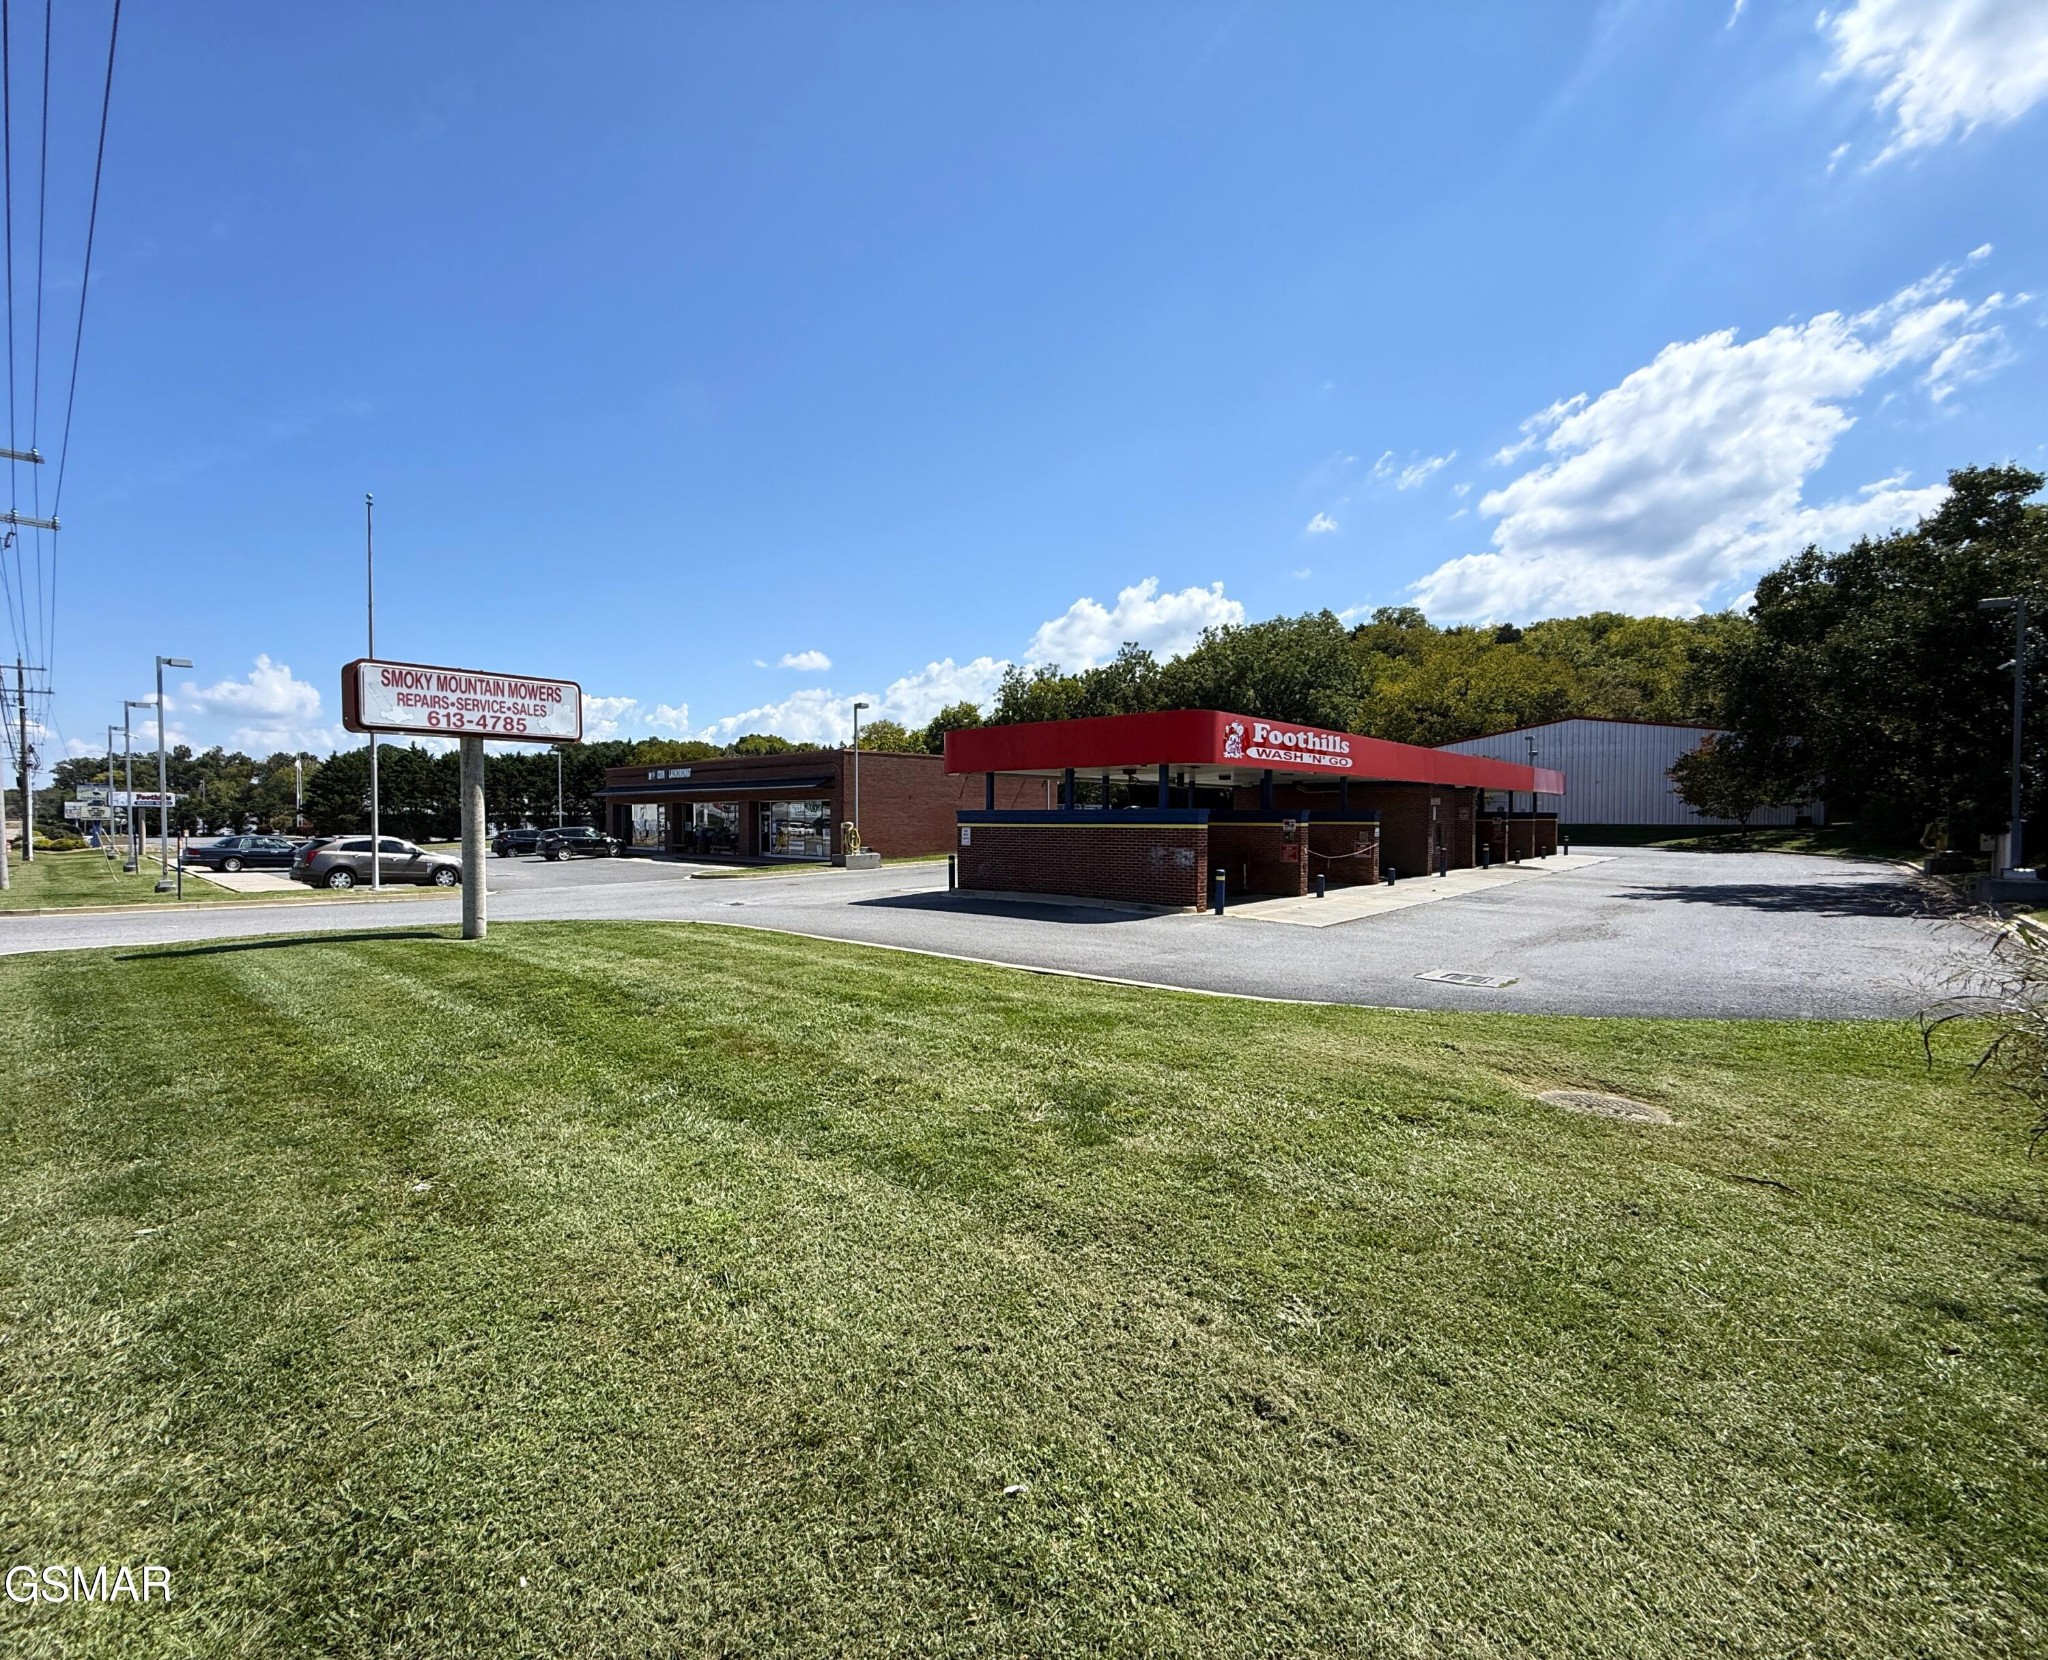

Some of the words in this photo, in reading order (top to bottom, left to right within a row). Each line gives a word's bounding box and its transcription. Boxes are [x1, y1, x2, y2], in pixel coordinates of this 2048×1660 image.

[381, 668, 433, 690] SMOKY
[437, 675, 505, 696] MOUNTAIN
[508, 682, 562, 704] MOWERS
[427, 710, 527, 733] 613-4785
[1253, 722, 1350, 754] Foothills
[1256, 748, 1303, 762] WASH
[1328, 757, 1348, 767] GO
